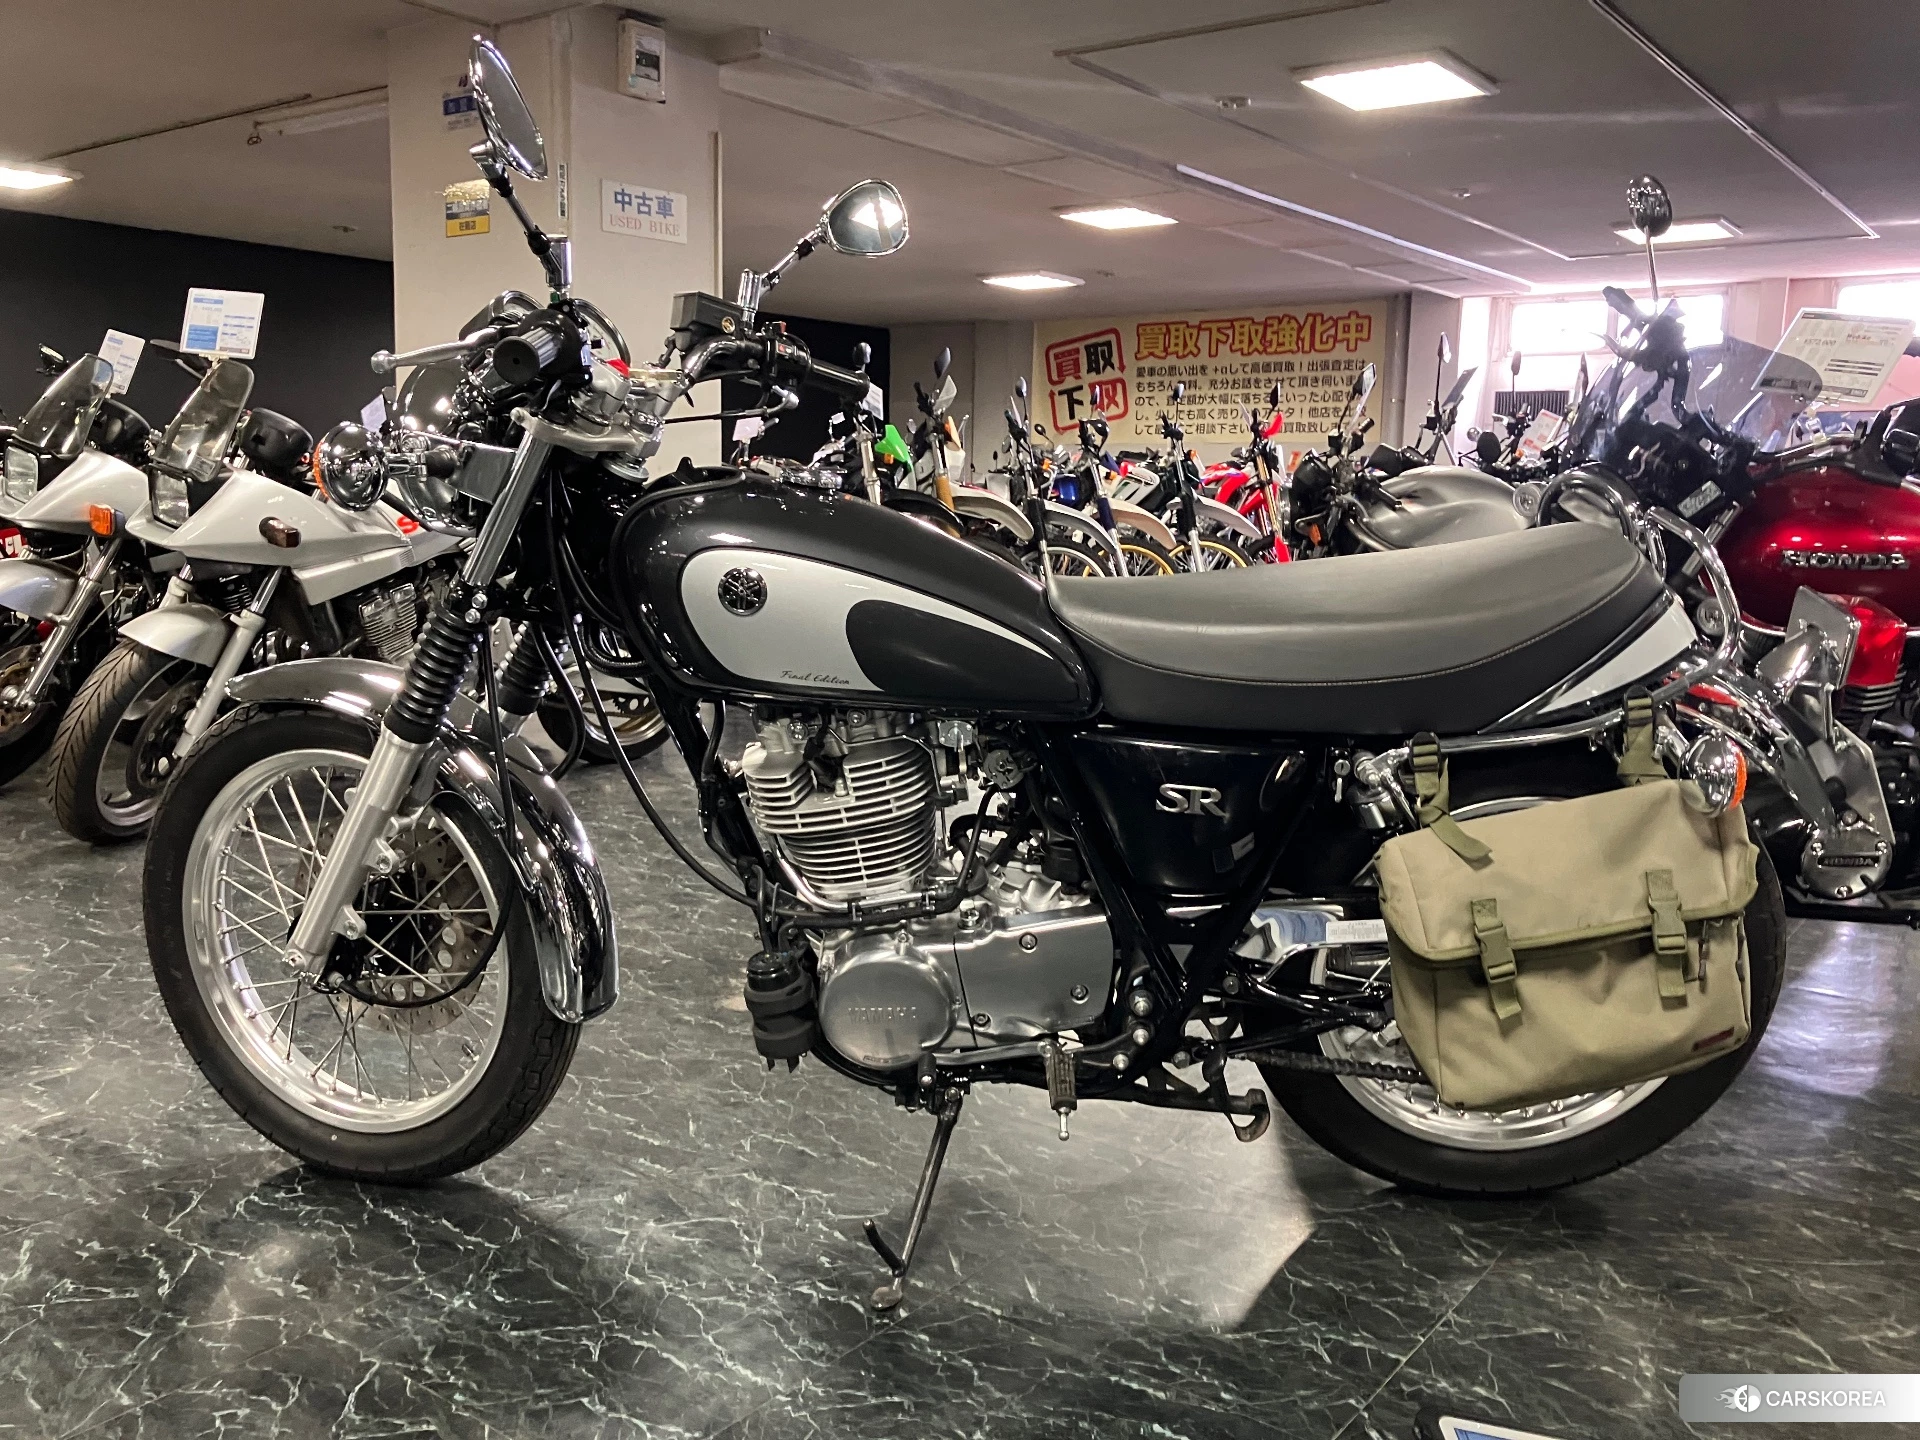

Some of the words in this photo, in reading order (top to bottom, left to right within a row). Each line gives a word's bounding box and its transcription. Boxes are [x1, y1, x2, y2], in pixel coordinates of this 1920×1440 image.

[613, 188, 675, 219] 中古車
[609, 213, 642, 230] USED
[649, 220, 680, 237] BIKE
[1135, 310, 1372, 361] 買取下取強化中
[1053, 339, 1116, 380] 買取
[1057, 380, 1120, 421] 下取
[1782, 550, 1910, 570] HONDA
[780, 670, 812, 681] Final
[813, 674, 850, 685] Edition
[1155, 784, 1229, 823] SR
[847, 1007, 917, 1022] YAMAHA
